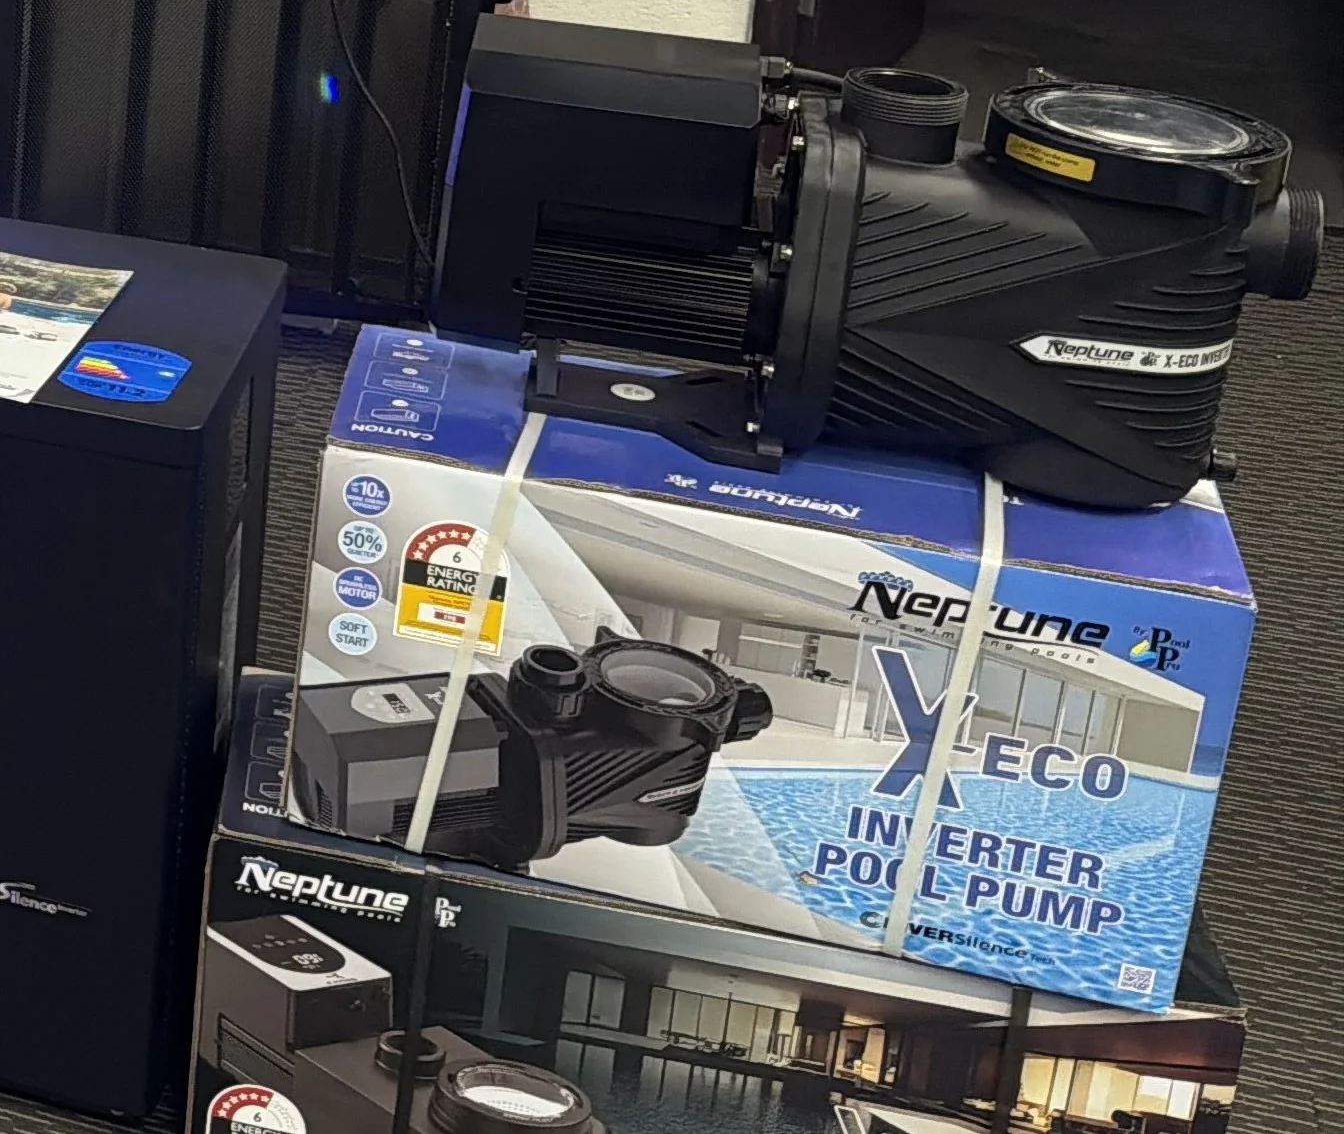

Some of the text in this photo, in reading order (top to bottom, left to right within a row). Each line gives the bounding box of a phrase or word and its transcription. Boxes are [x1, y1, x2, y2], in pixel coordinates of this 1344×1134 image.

[1043, 339, 1135, 361] Neptune
[1163, 352, 1199, 369] X-ECO
[350, 422, 435, 442] CAUTION
[360, 480, 385, 499] 10x
[707, 481, 863, 520] Neptune
[342, 531, 383, 553] 50%
[452, 551, 462, 564] 6
[426, 565, 481, 583] ENERGY
[337, 585, 377, 601] MOTOR
[426, 576, 479, 596] RATING
[847, 580, 1111, 648] Nepune
[339, 620, 369, 635] SOFT
[335, 633, 369, 648] START
[848, 613, 1097, 665] for swiming pools
[1150, 625, 1191, 653] Pool
[1155, 645, 1182, 672] Pro
[234, 862, 410, 916] Neptune
[964, 872, 1126, 936] PUMP
[1029, 952, 1057, 967] Tech
[253, 1111, 263, 1123] 6
